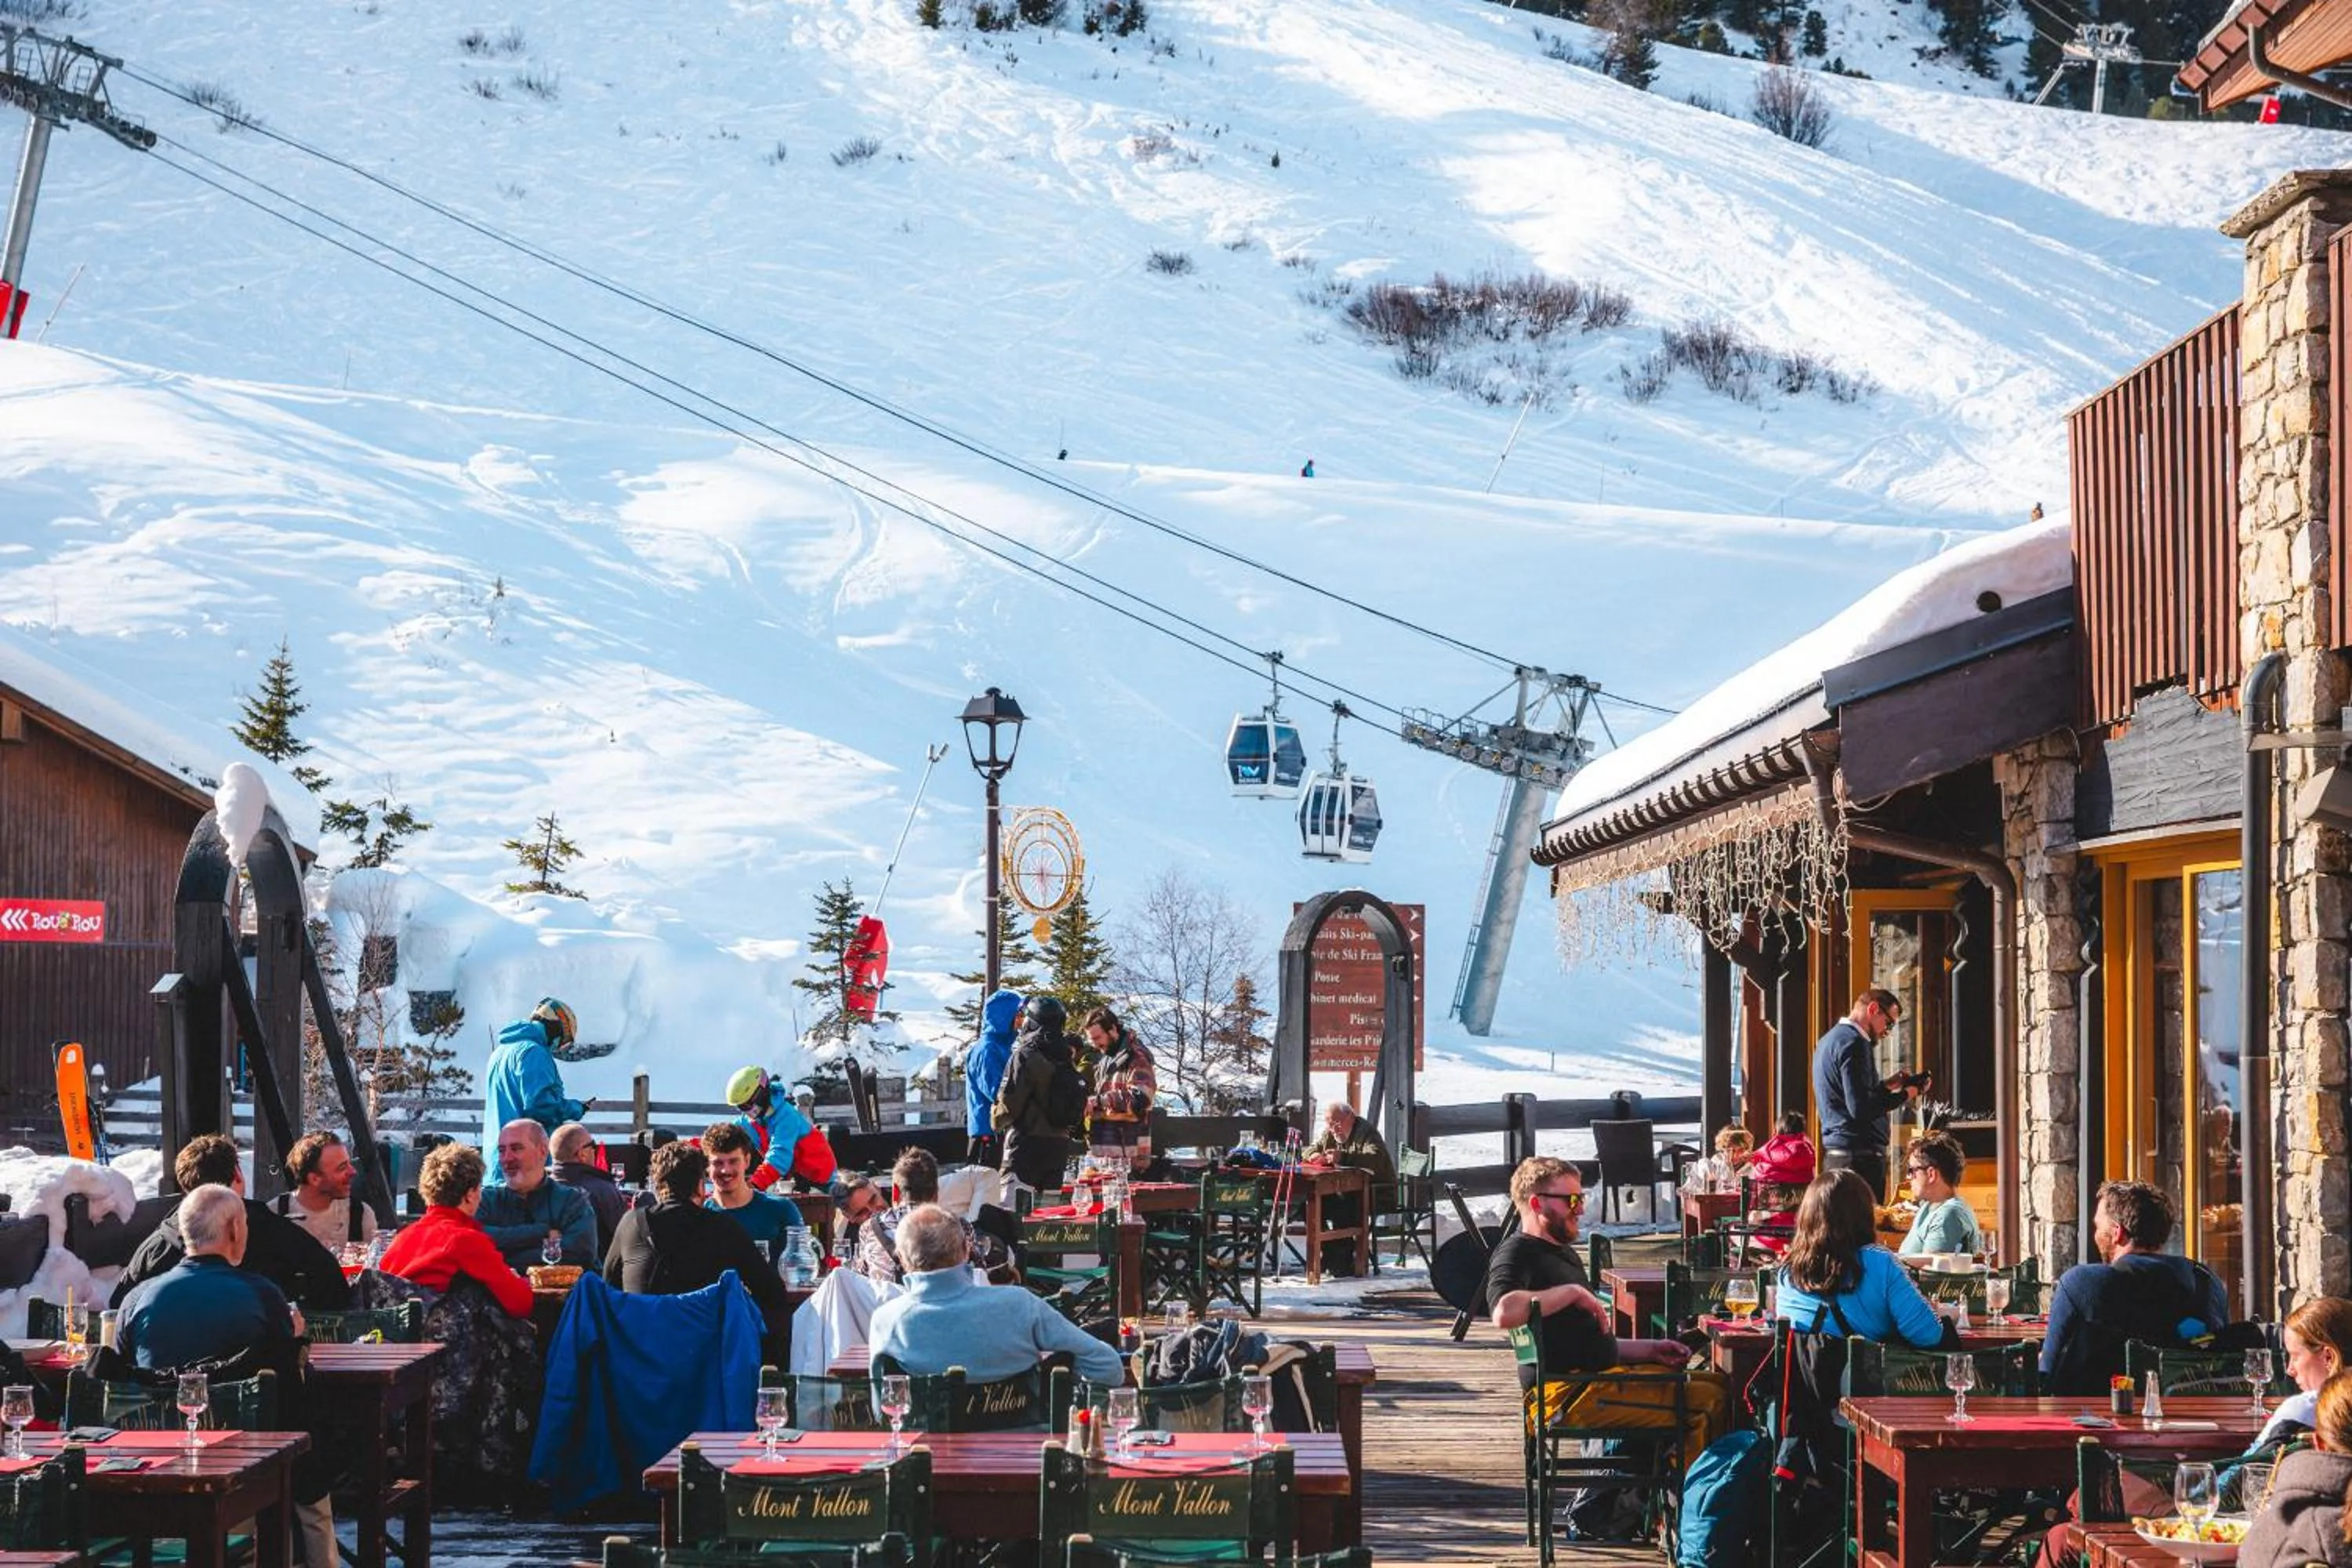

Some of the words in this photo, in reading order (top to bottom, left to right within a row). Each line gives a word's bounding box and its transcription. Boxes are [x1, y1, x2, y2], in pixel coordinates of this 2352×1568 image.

[1327, 948, 1339, 960] de
[1341, 947, 1357, 960] Ski
[1361, 949, 1384, 960] Fran
[1311, 993, 1335, 1004] binet
[1311, 1035, 1348, 1046] arderie
[1349, 1035, 1363, 1045] les
[982, 1383, 1027, 1413] Vallon
[738, 1486, 802, 1518] Mont
[812, 1486, 871, 1518] Vallon
[1098, 1479, 1164, 1515] Mont
[1174, 1479, 1232, 1515] Vallon
